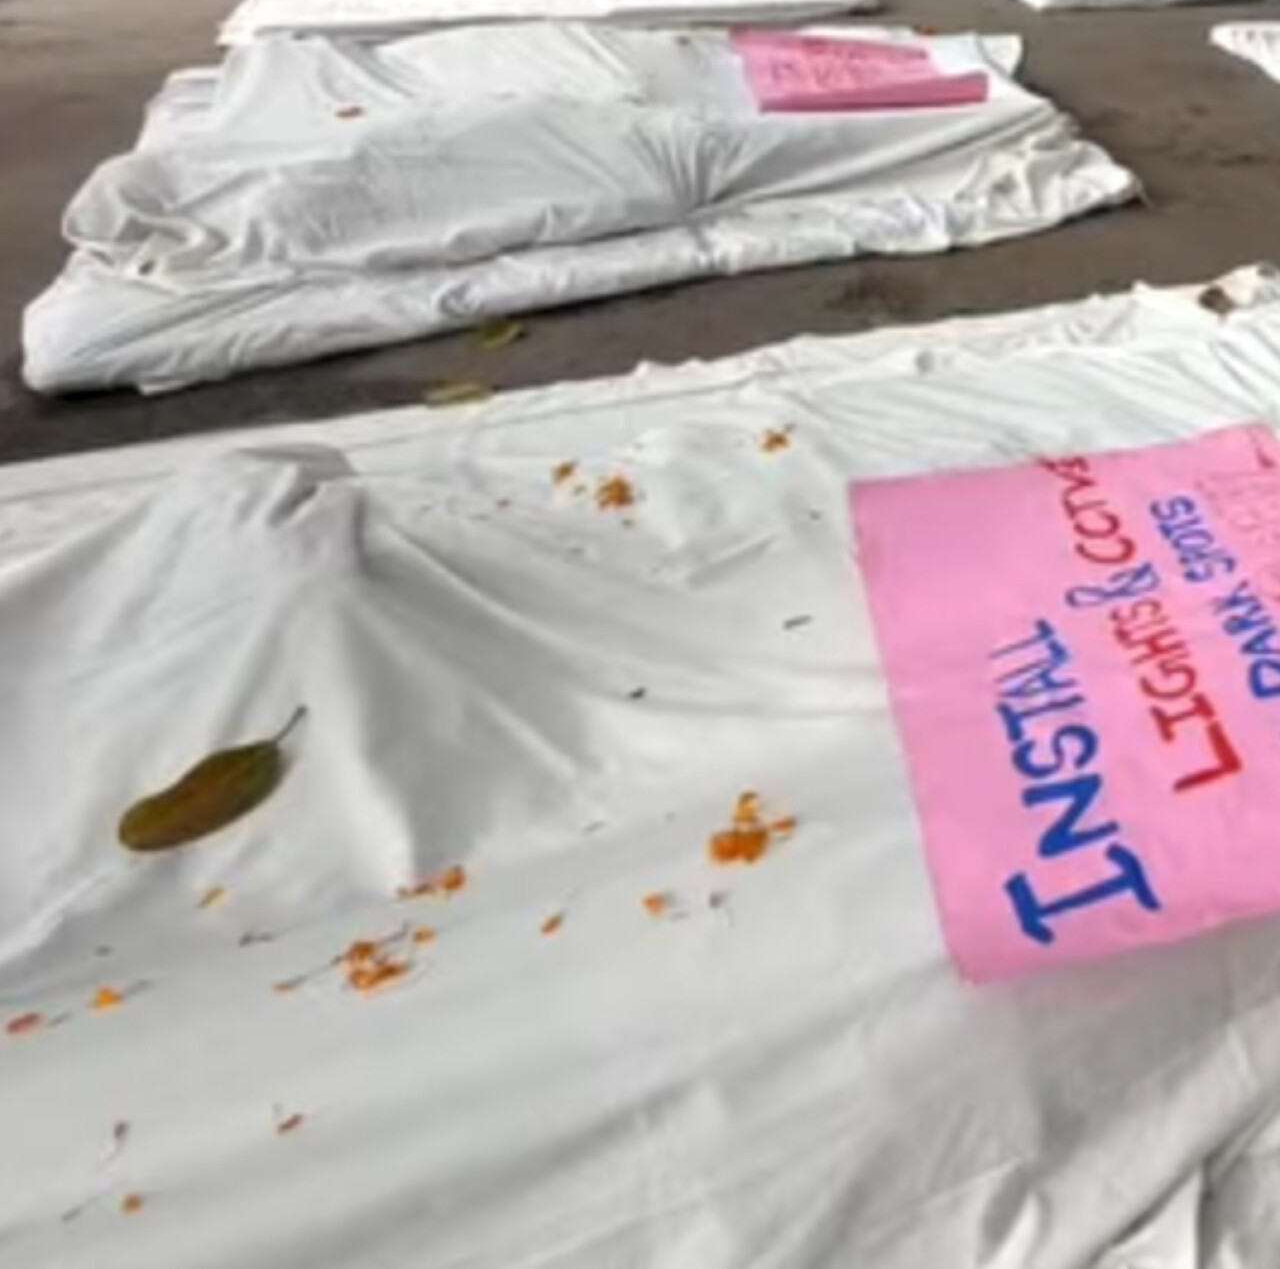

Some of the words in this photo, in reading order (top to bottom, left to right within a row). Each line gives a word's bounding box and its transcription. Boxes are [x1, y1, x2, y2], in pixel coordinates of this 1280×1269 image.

[1064, 562, 1161, 610] &
[1149, 495, 1237, 583] SPOTS
[1108, 597, 1242, 792] LIGHTS
[988, 618, 1162, 945] INSTALL
